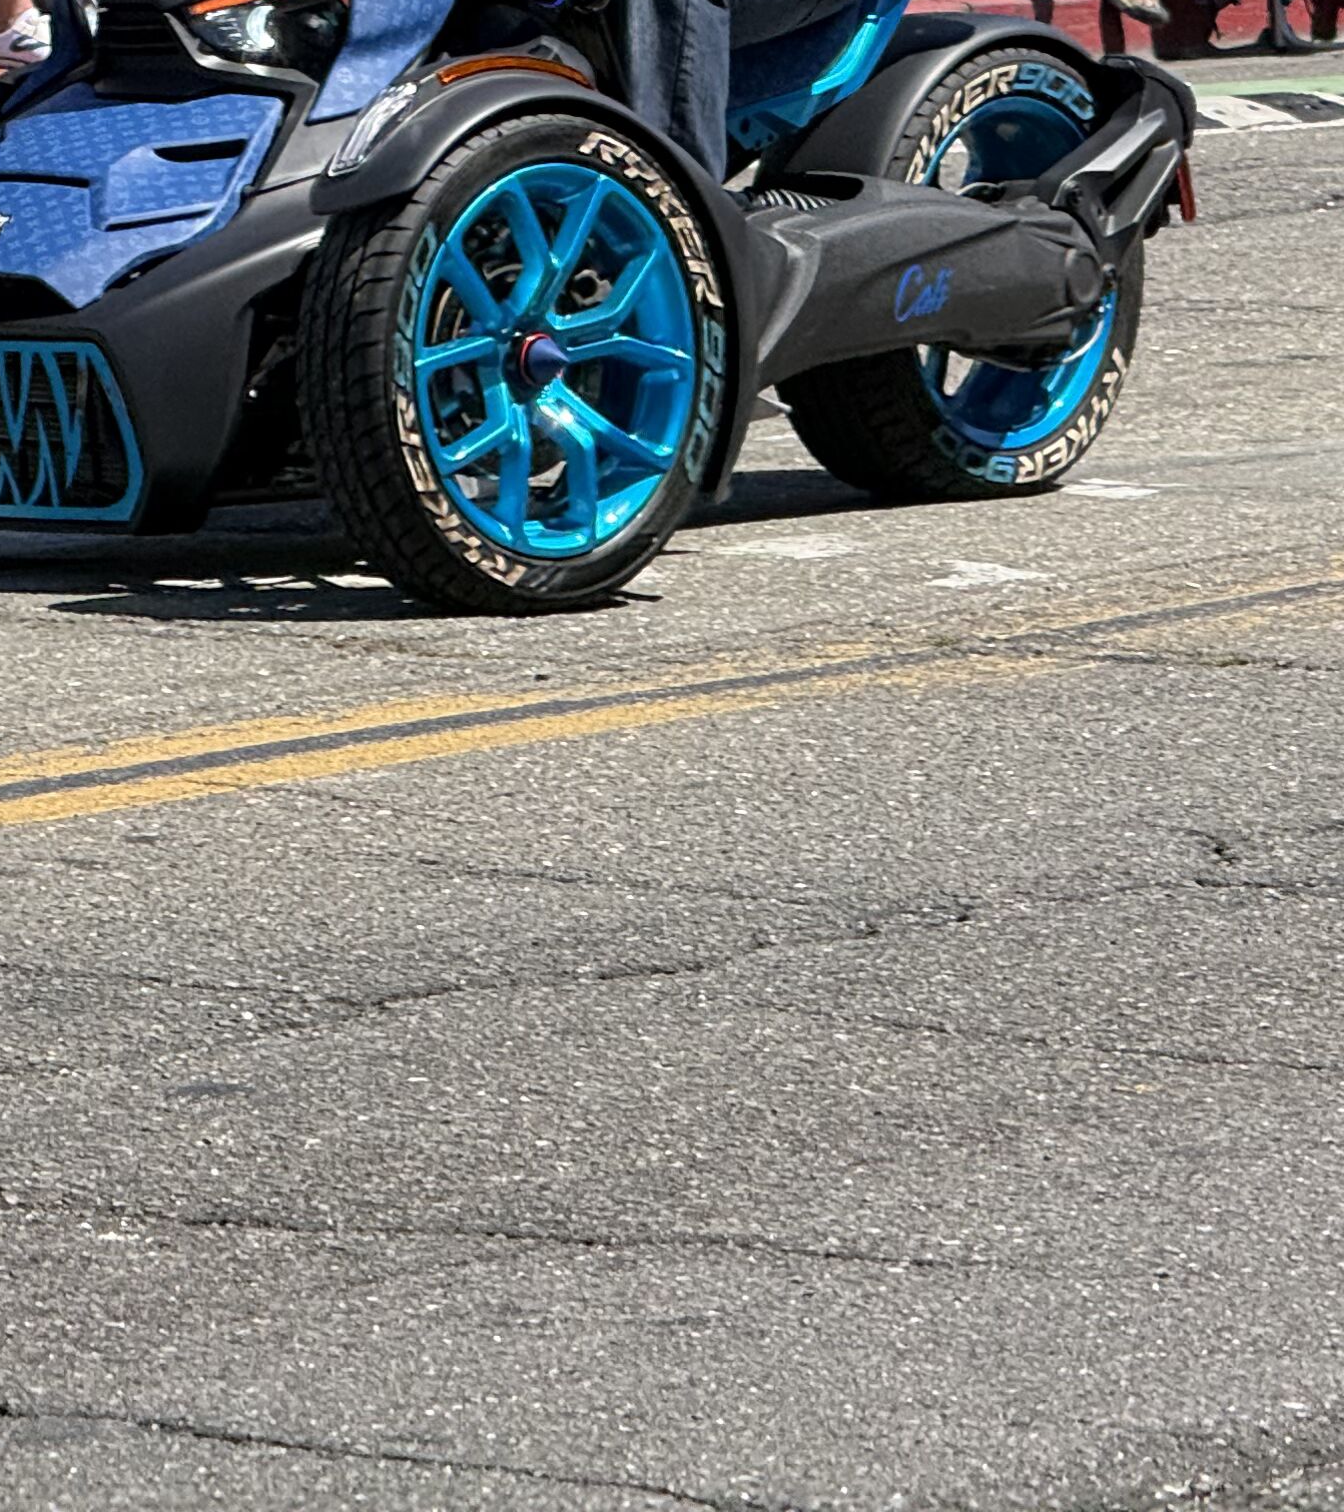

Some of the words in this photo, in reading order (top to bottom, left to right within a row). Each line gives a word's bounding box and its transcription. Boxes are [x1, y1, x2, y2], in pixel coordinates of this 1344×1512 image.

[905, 64, 1019, 185] RYKER
[1012, 62, 1096, 121] 900
[578, 131, 725, 308] RYKER
[683, 317, 727, 484] 900
[395, 391, 528, 588] RYKER
[1013, 347, 1128, 485] RYKER
